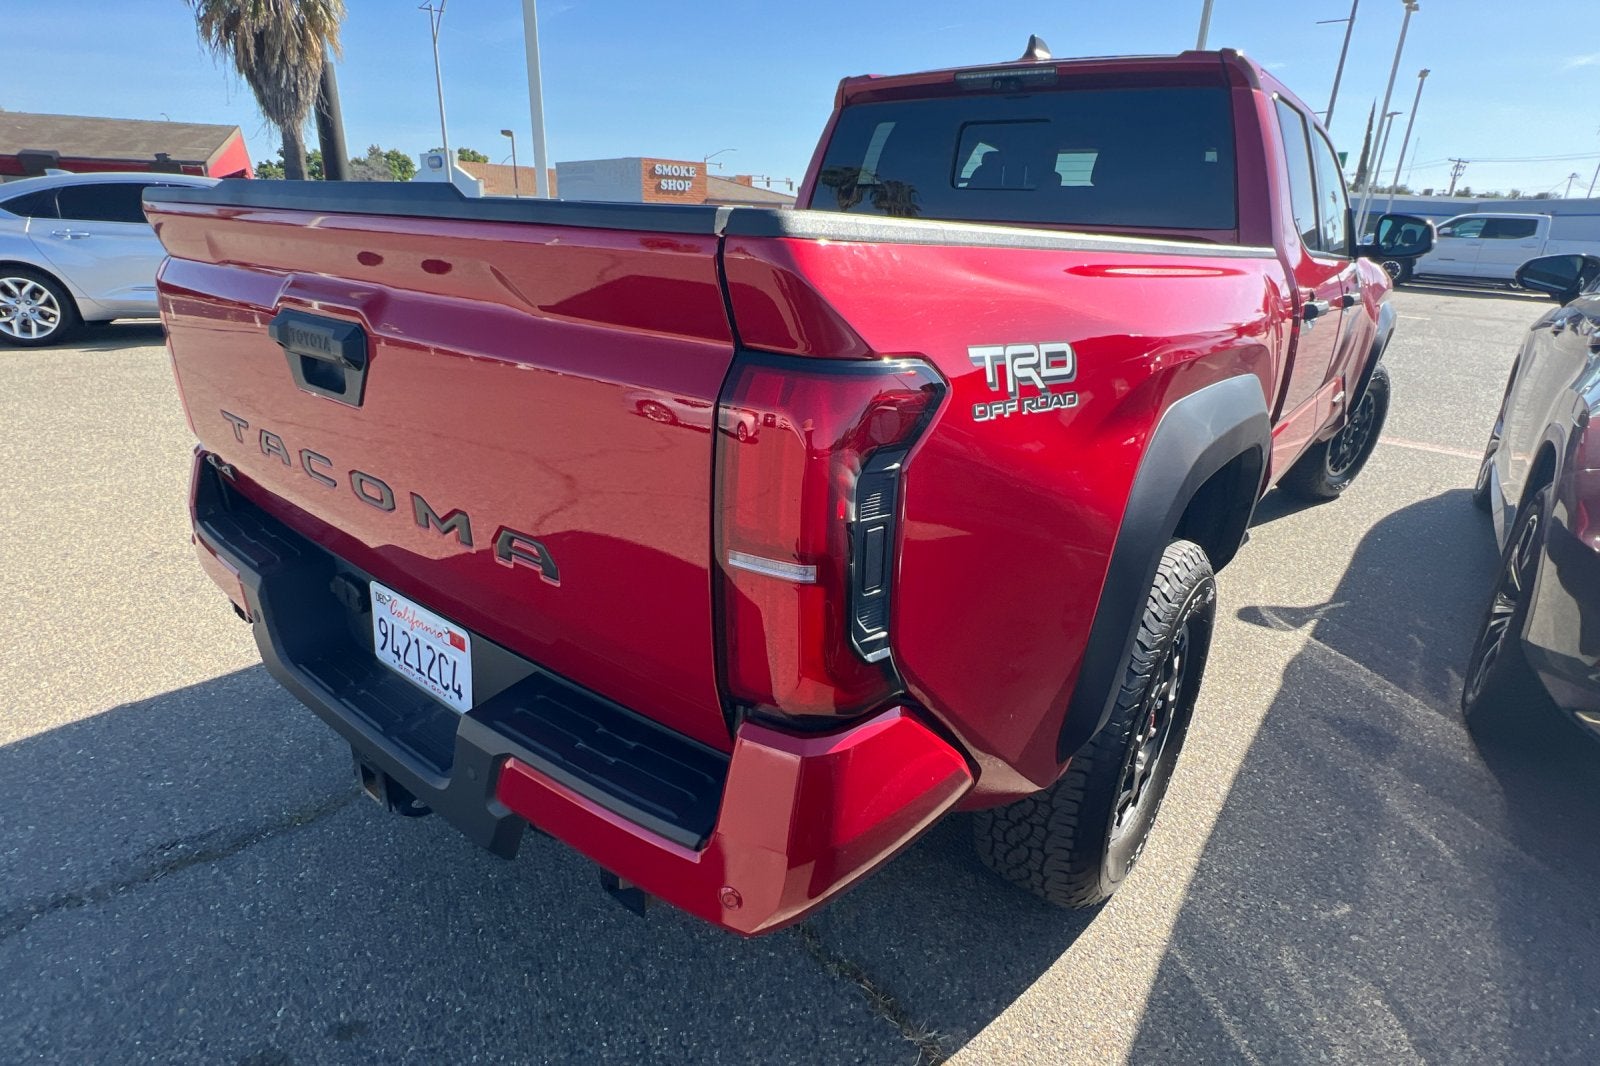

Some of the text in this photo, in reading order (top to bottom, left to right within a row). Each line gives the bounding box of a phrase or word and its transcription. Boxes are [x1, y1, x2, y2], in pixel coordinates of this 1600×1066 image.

[654, 163, 697, 177] SMOKE
[660, 179, 693, 192] SHOP
[288, 327, 331, 352] TOYOTA
[967, 342, 1077, 398] TRD
[972, 391, 1079, 422] OFF ROAD
[220, 409, 561, 587] TACOMA
[390, 599, 447, 642] California
[378, 617, 464, 701] 94212C4
